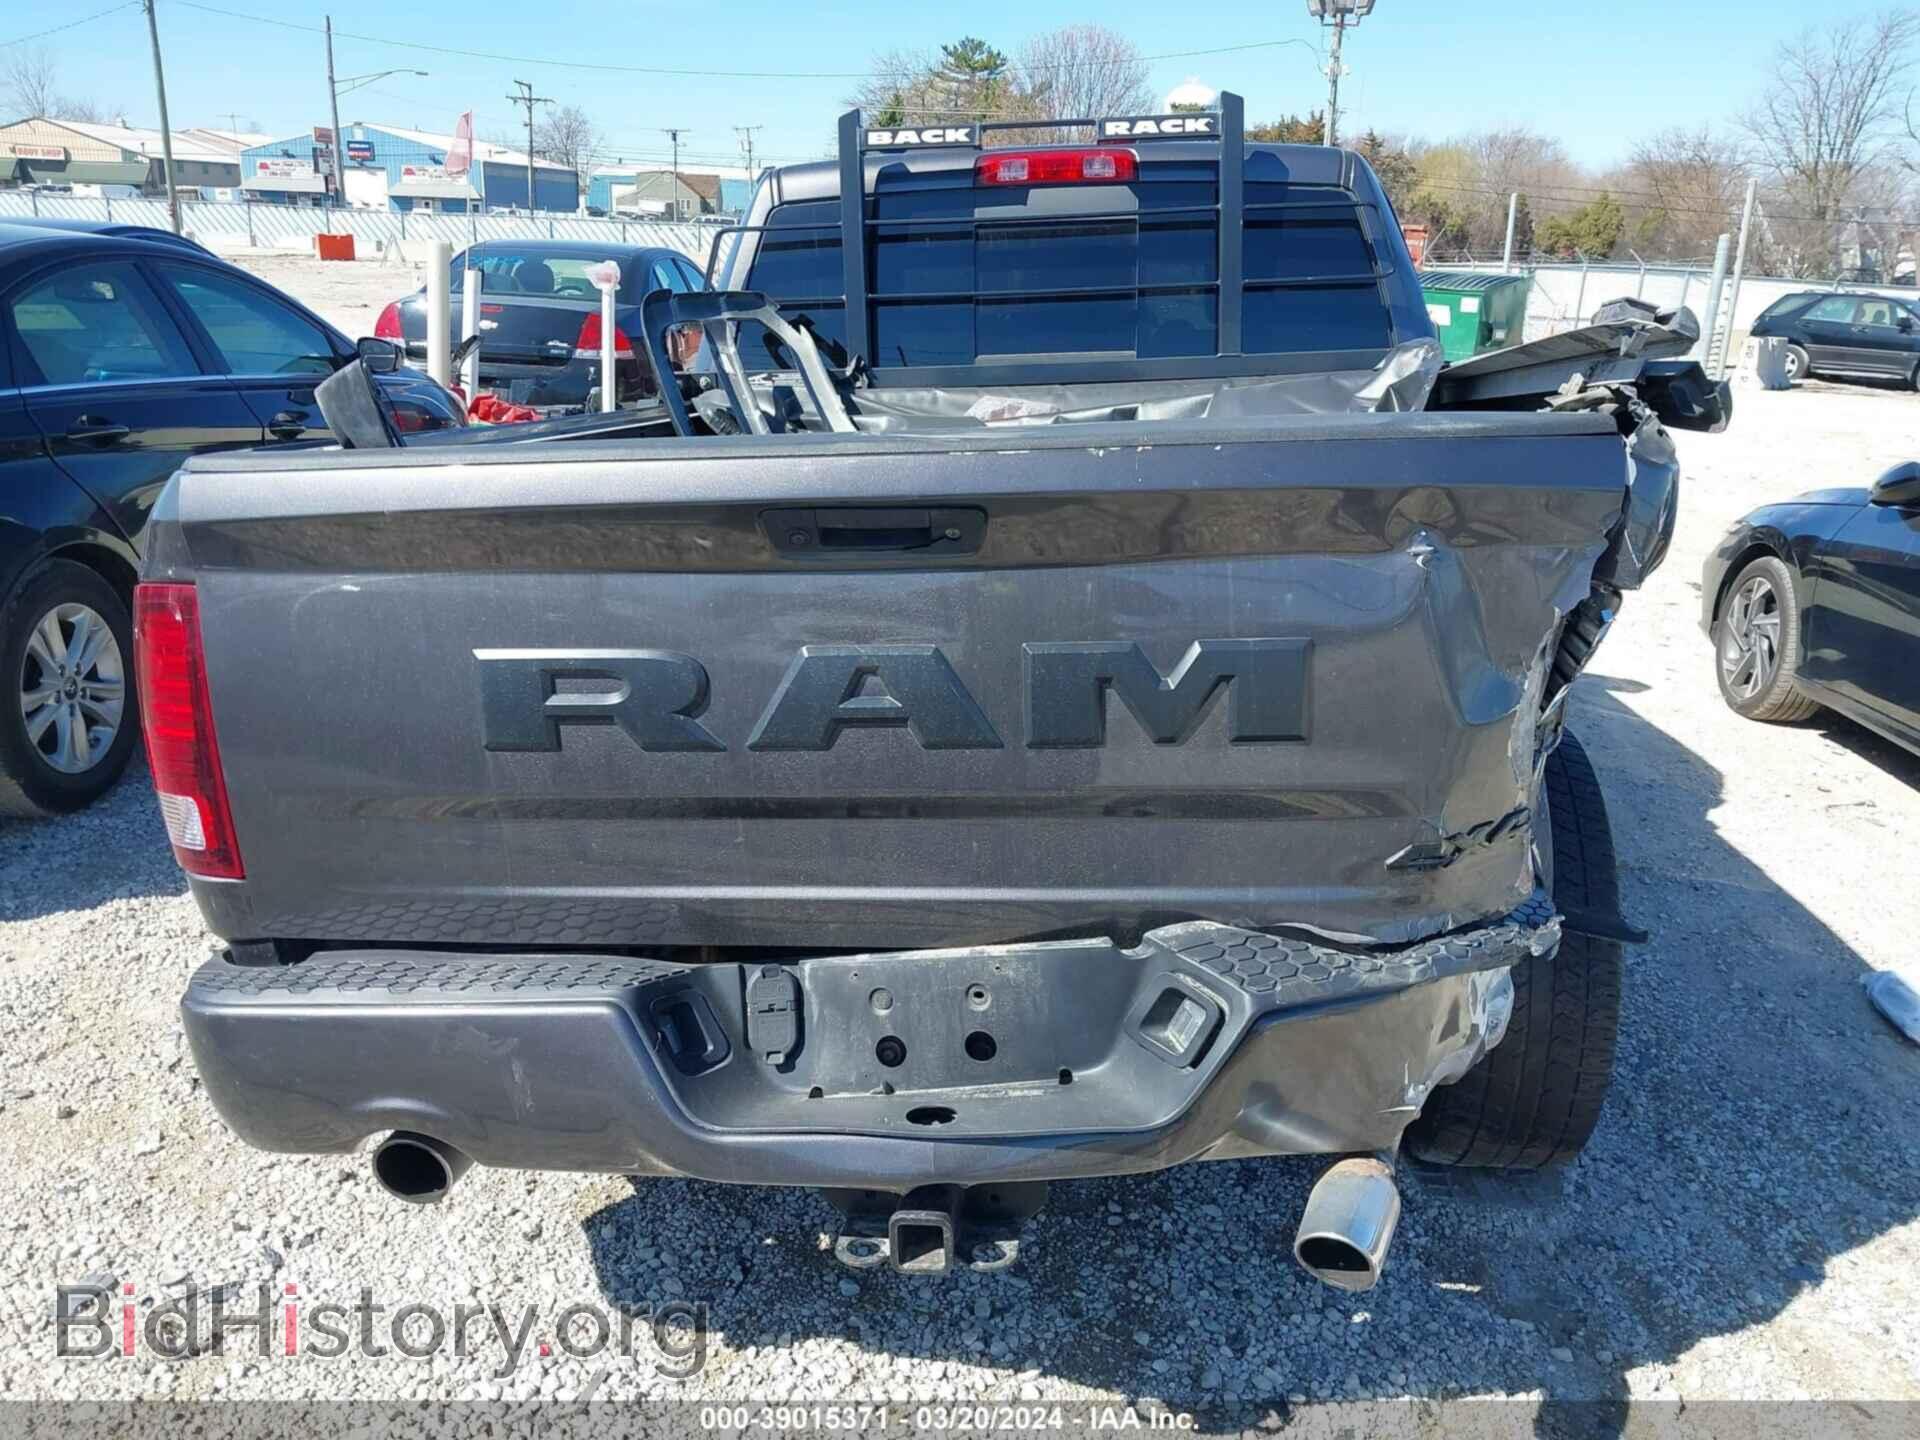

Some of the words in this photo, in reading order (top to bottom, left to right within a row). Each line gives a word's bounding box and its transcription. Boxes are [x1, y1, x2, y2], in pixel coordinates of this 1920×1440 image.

[867, 128, 971, 146] BACK
[1105, 117, 1213, 136] RACK
[471, 636, 1313, 752] RAM
